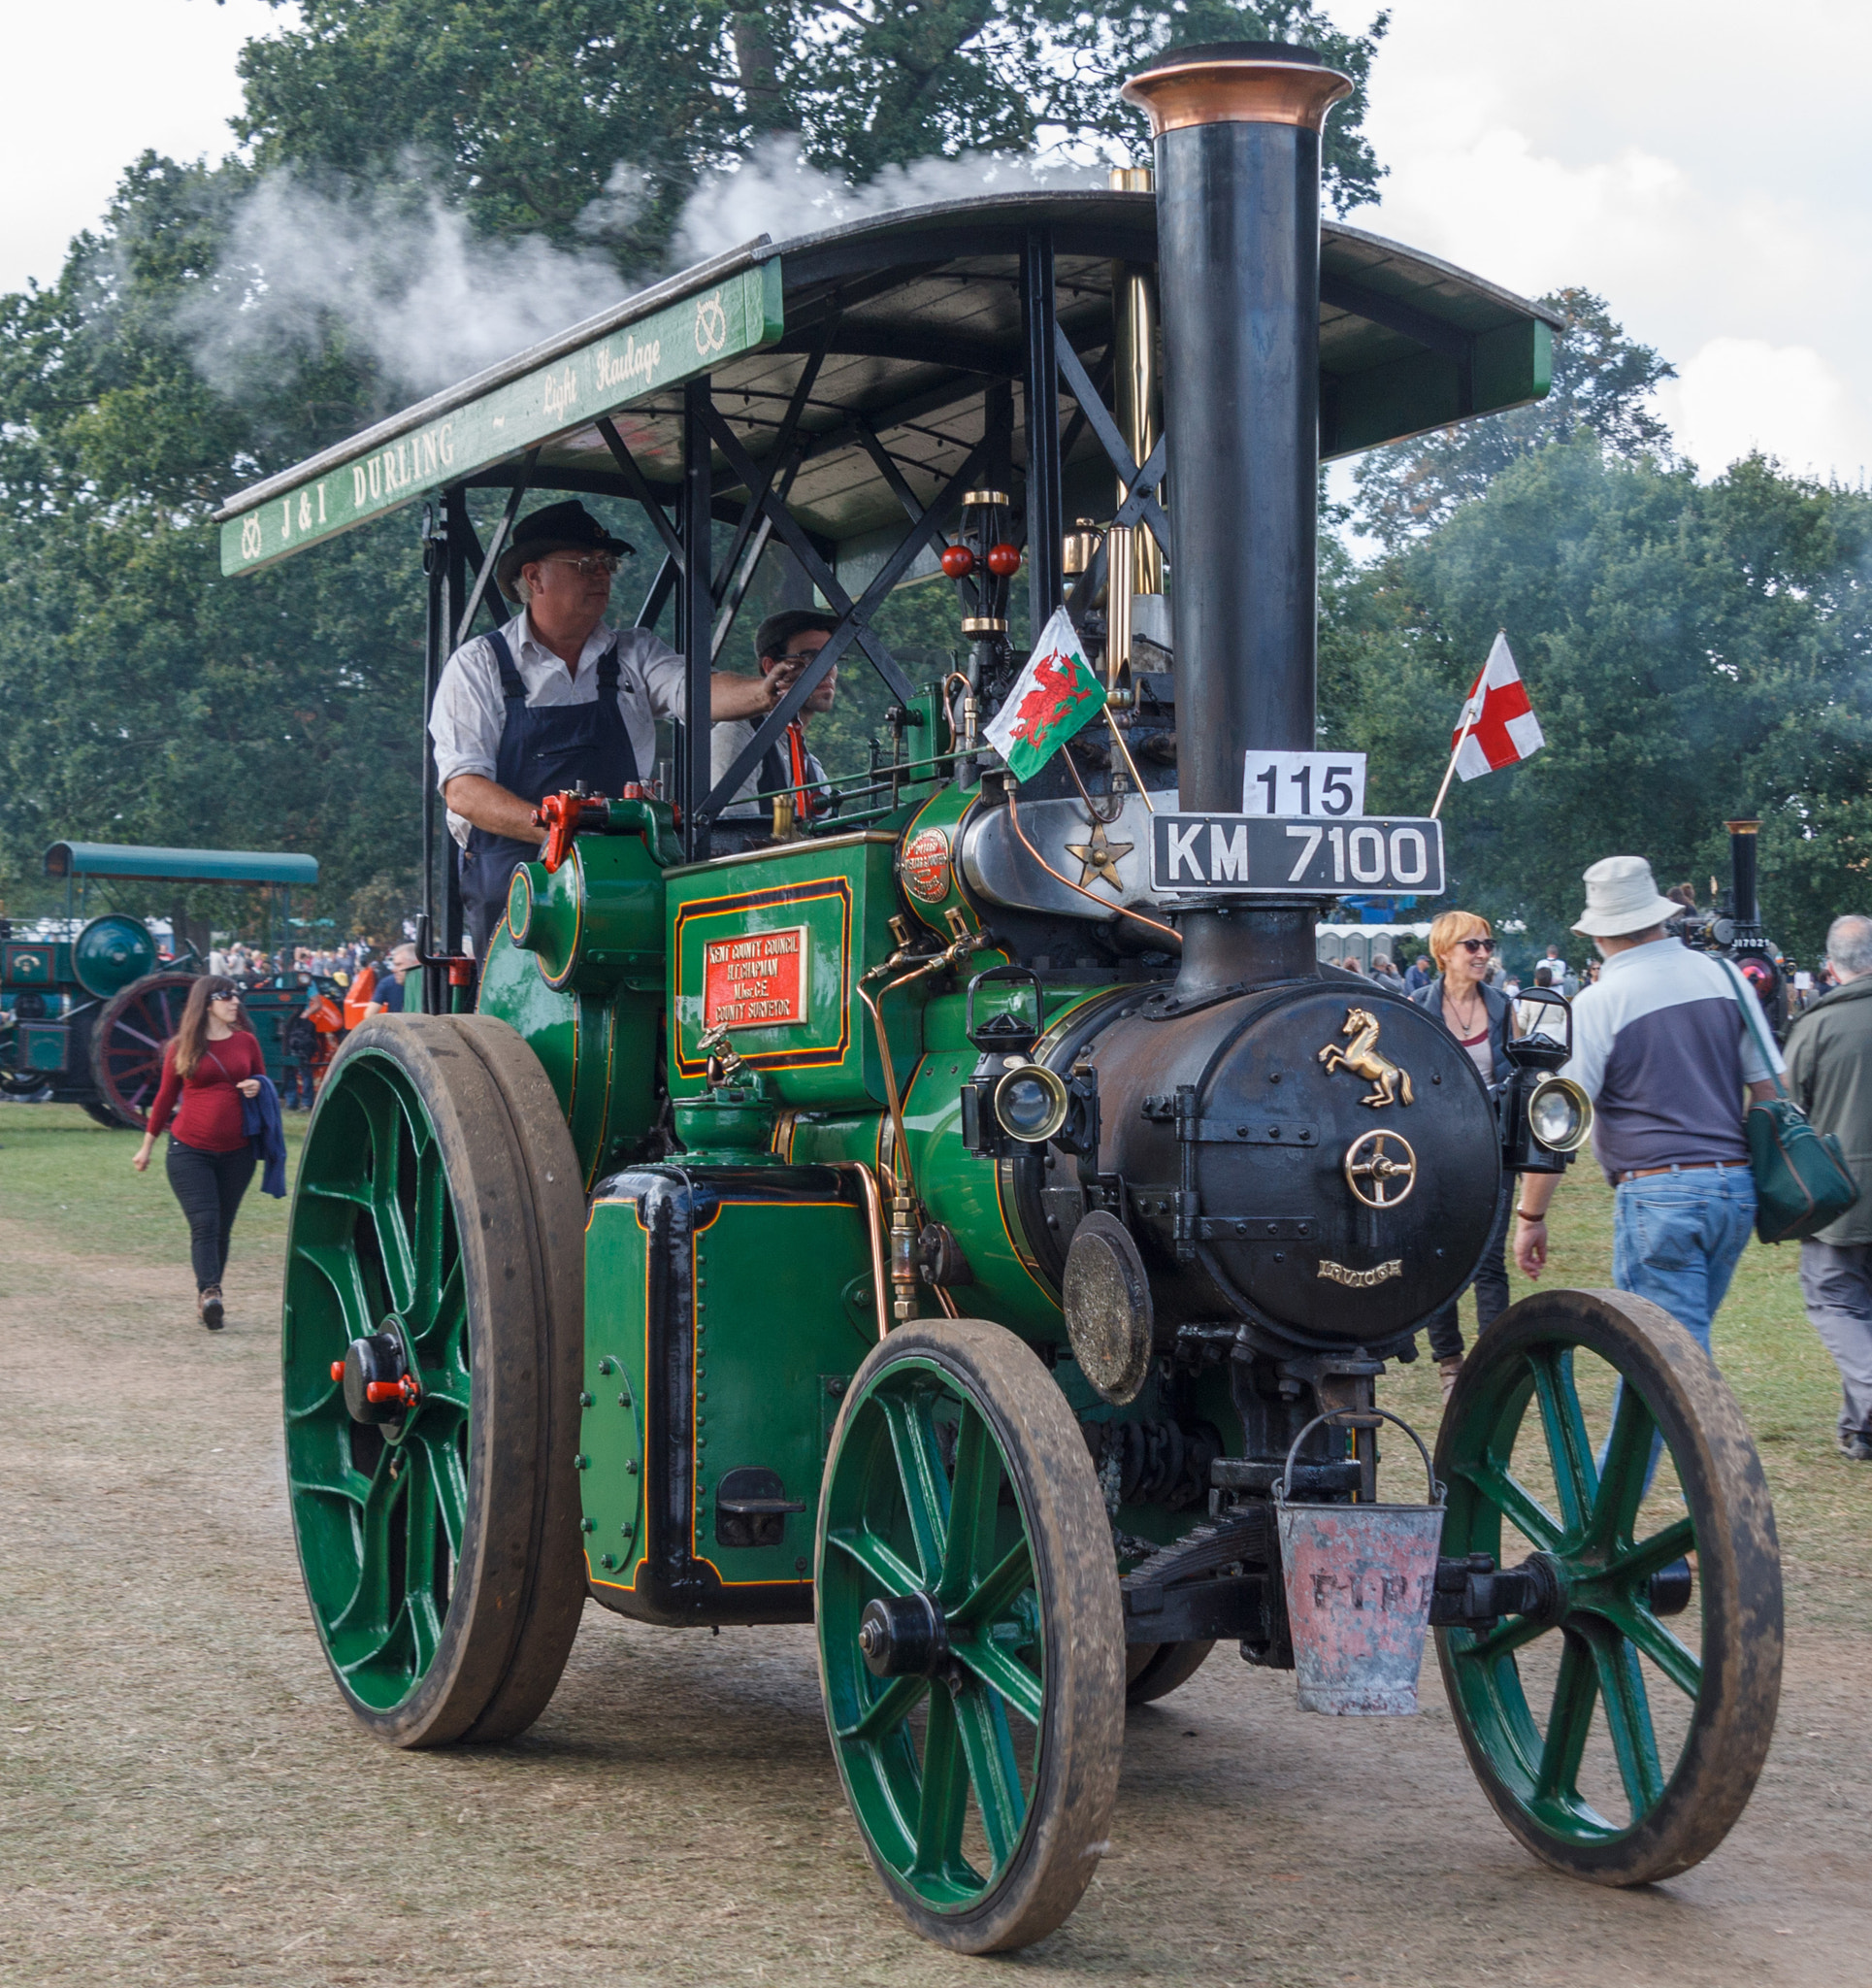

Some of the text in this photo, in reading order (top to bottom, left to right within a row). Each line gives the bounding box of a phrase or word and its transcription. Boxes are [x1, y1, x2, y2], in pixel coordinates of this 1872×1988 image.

[352, 422, 454, 509] DURLING
[542, 366, 577, 422] Light
[596, 335, 661, 391] Haulage
[1257, 765, 1353, 816] 115
[1167, 823, 1428, 884] KM 7100
[709, 937, 799, 964] KENT COUNTY COUNCIL
[715, 999, 790, 1022] COUNTY SURVEYOR
